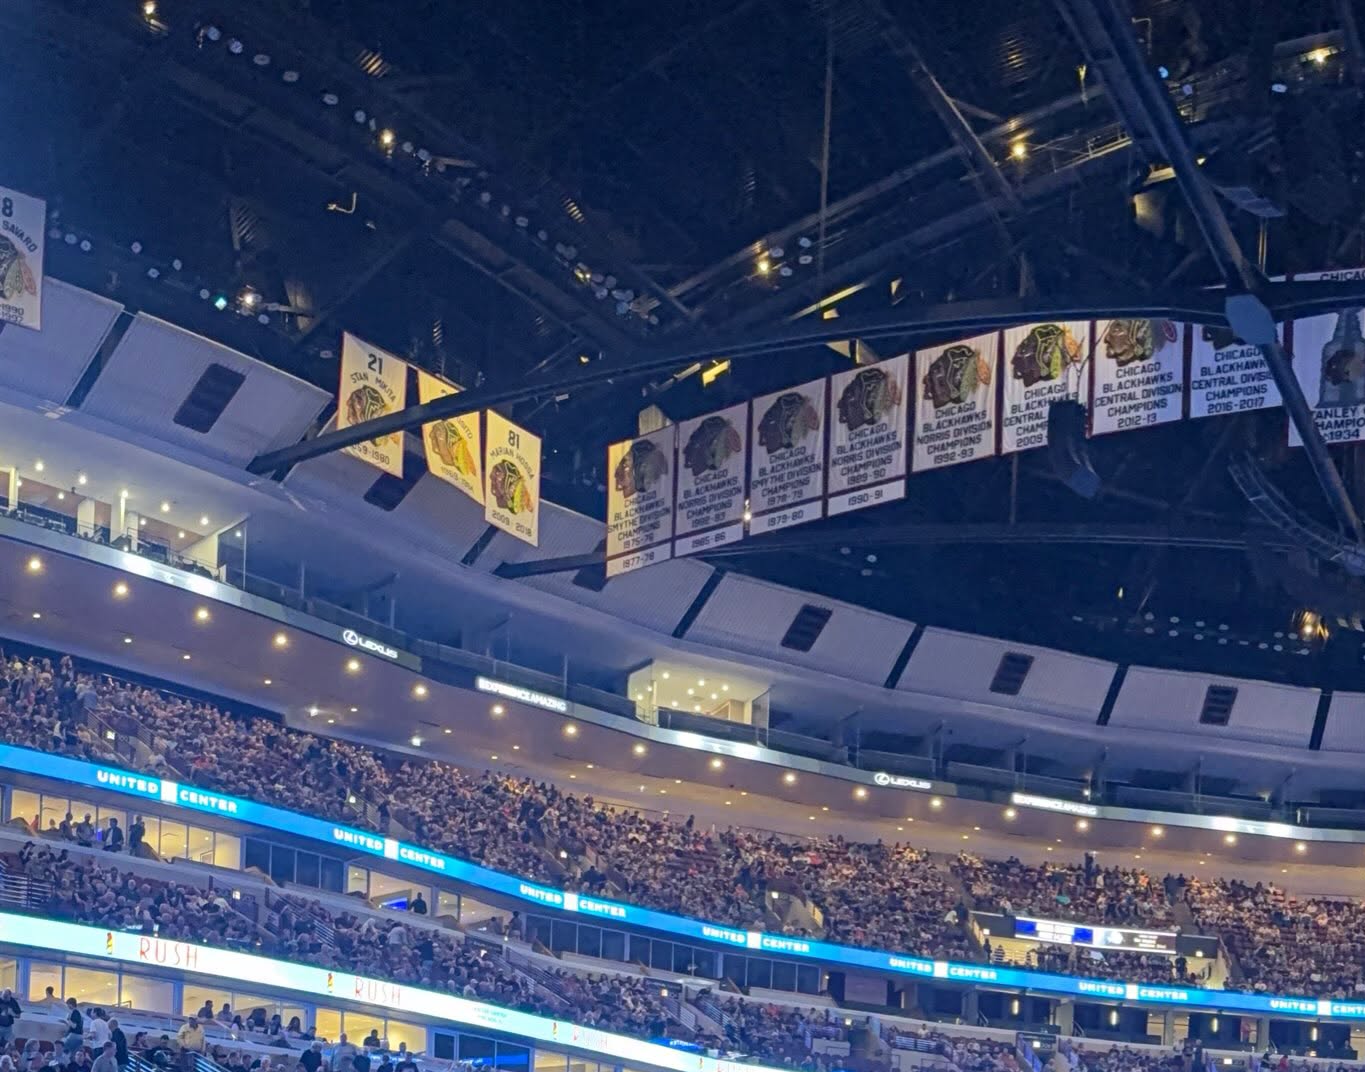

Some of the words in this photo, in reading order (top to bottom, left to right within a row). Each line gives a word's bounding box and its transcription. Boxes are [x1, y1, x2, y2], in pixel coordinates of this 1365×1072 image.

[2, 220, 37, 253] SAVARD
[368, 354, 382, 374] 21
[1115, 362, 1161, 379] CHICAGO
[350, 372, 368, 383] STAN
[375, 376, 397, 403] MIKITA
[1103, 372, 1173, 394] BLACKHAWKS
[1192, 375, 1237, 391] CENTRAL
[1095, 391, 1140, 407] CENTRAL
[1142, 384, 1183, 402] DIVISION
[1205, 385, 1268, 402] CHAMPIONS
[935, 402, 976, 419] CHICAGO
[1107, 399, 1168, 417] CHAMPIONS
[1311, 407, 1359, 420] TANLEY
[922, 410, 986, 433] BLACKHAWKS
[1117, 413, 1157, 428] 2012-13
[508, 430, 519, 449] 81
[917, 430, 950, 445] NORRIS
[927, 434, 982, 455] CHAMPIONS
[1329, 429, 1360, 441] 1934
[358, 638, 398, 659] LEXUS
[97, 769, 159, 795] UNITED
[179, 790, 238, 814] CENTER
[891, 776, 932, 790] LEXUS
[333, 828, 384, 852] UNITED
[398, 847, 446, 870] CENTER
[519, 884, 562, 904] UNITED
[578, 897, 626, 918] CENTER
[702, 925, 746, 945] UNITED
[762, 936, 810, 953] CENTER
[139, 936, 198, 969] RUSH
[889, 957, 933, 975] UNITED
[949, 965, 997, 982] CENTER
[355, 976, 402, 1005] RUSH
[1078, 981, 1124, 998] UNITED
[1138, 986, 1188, 1001] CENTER
[1270, 998, 1316, 1012] UNITED
